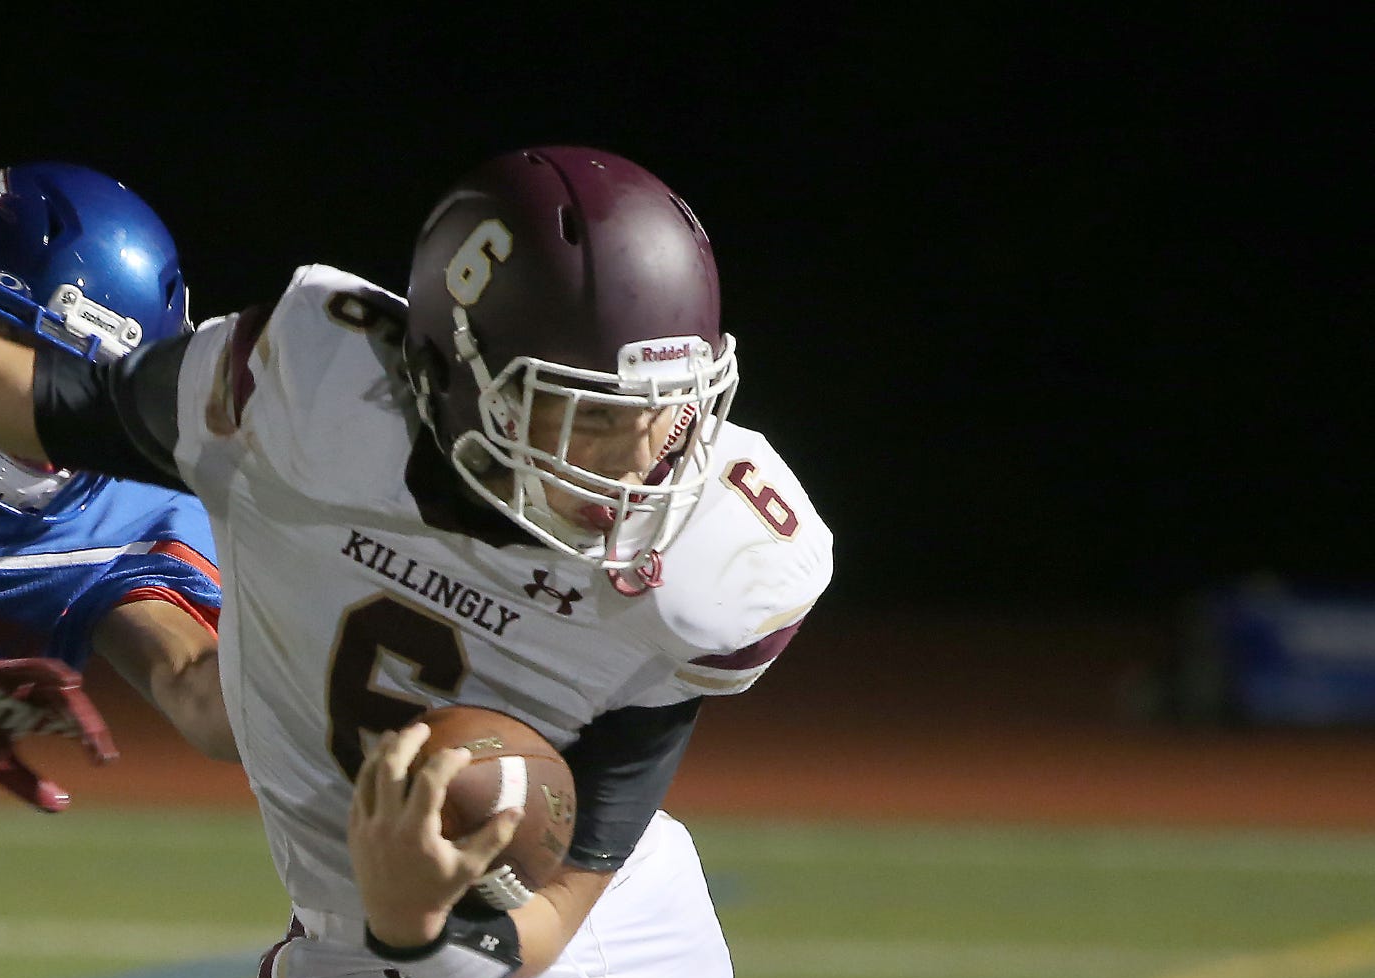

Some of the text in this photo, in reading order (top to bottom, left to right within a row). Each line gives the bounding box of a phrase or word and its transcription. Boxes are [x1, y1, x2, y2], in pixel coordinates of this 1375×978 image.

[446, 218, 513, 305] 6
[642, 343, 690, 362] Riddell
[720, 457, 802, 543] 6
[341, 529, 520, 636] KILLINGLY
[325, 588, 472, 787] 6
